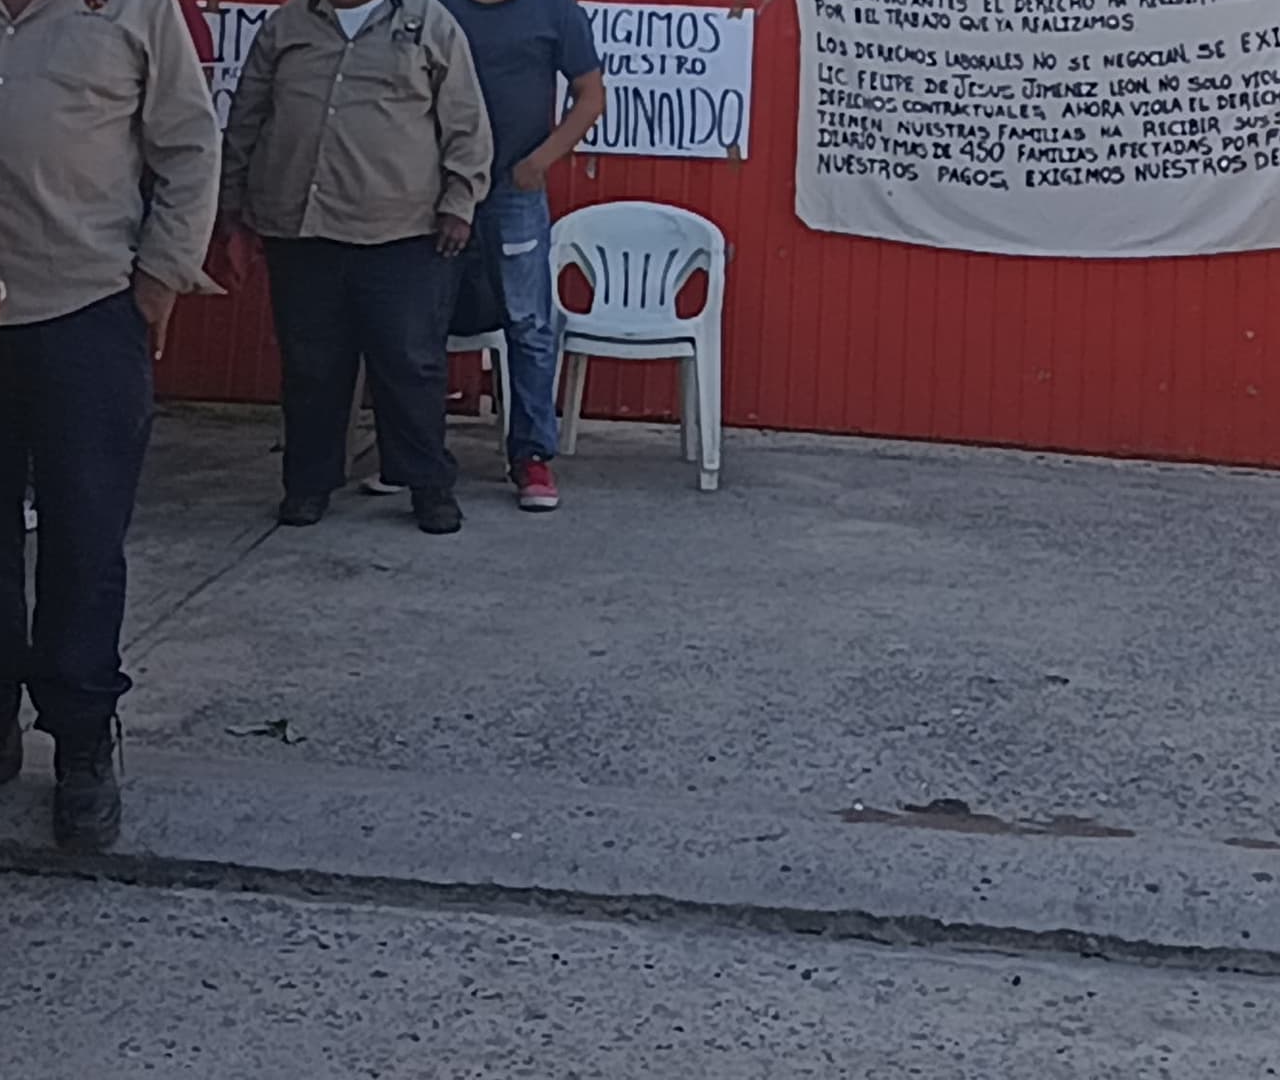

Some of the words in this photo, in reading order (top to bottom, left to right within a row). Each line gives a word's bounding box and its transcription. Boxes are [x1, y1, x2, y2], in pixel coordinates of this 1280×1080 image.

[959, 15, 989, 32] QUE
[995, 15, 1014, 32] YA
[1022, 14, 1135, 33] REALIZAMOS
[817, 31, 848, 57] LOS
[945, 50, 1024, 71] LABORALES
[1033, 51, 1057, 70] NO
[1068, 54, 1090, 71] SE
[1196, 40, 1226, 60] SE
[818, 62, 848, 85] LIC
[858, 69, 914, 93] FELIPE
[924, 78, 948, 95] DE
[951, 73, 1015, 99] JESUS
[1022, 77, 1099, 99] JIMENEZ
[1158, 74, 1180, 92] NO
[1187, 74, 1232, 92] SOLO
[817, 108, 883, 133] TIENEN
[897, 120, 990, 141] NUESTRAS
[997, 123, 1086, 143] FAMILIAS
[1100, 124, 1123, 138] HA
[1142, 116, 1220, 138] RECIBIR
[1062, 100, 1124, 124] AHORA
[1130, 97, 1183, 117] VIOLA
[1189, 95, 1210, 112] EL
[879, 136, 891, 154] Y
[893, 139, 928, 160] MAS
[932, 142, 952, 160] DE
[959, 141, 1006, 164] 450
[1017, 143, 1098, 164] FAMILIAS
[1106, 137, 1213, 161] AFECTADAS
[1222, 130, 1261, 153] POR
[817, 153, 919, 182] NUESTROS
[1025, 168, 1125, 188] EXIGIMOS
[1134, 154, 1247, 182] NUESTROS
